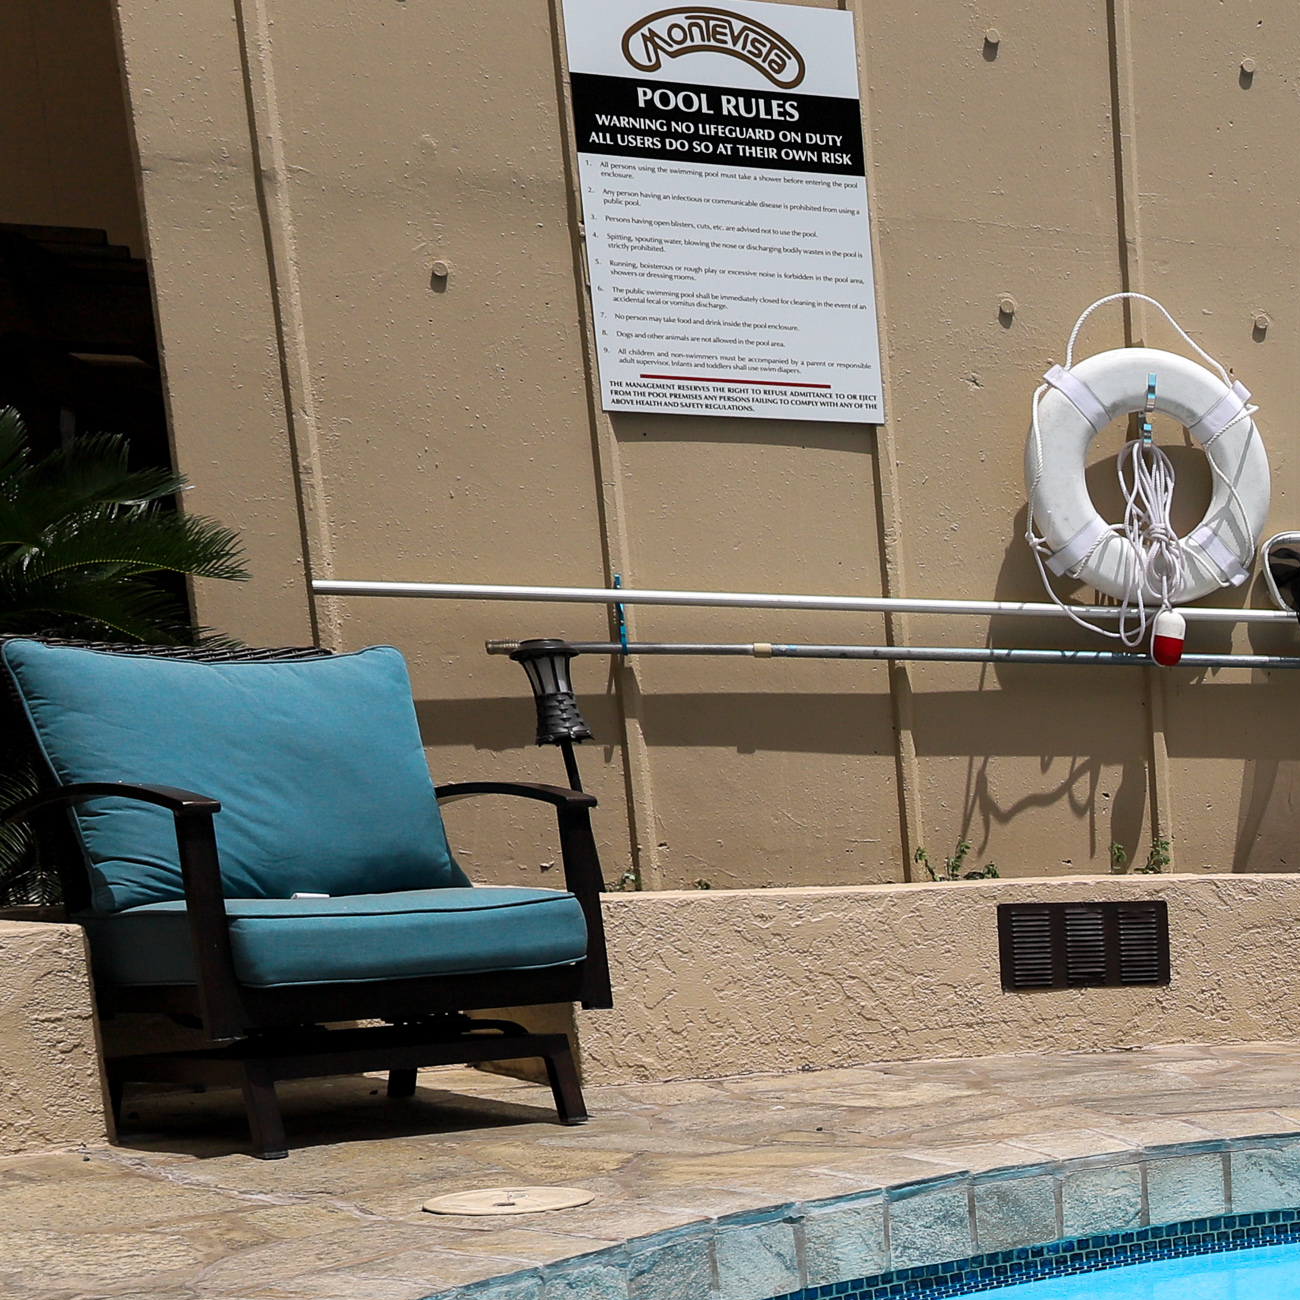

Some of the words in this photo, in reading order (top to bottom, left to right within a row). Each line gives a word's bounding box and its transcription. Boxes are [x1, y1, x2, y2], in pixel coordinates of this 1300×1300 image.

[636, 87, 714, 114] POOL
[720, 95, 799, 121] RULES
[595, 113, 667, 131] WARNING
[671, 121, 694, 134] NO
[698, 123, 775, 141] LIFEGUARD
[778, 130, 801, 143] ON
[805, 132, 842, 146] DUTY
[589, 131, 614, 145] ALL
[616, 133, 661, 149] USERS
[665, 138, 689, 151] DO
[692, 140, 713, 153] SO
[716, 143, 733, 155] AT
[736, 144, 778, 159] THEIR
[781, 148, 817, 162] OWN
[821, 151, 852, 165] RISK
[599, 160, 609, 168] All
[609, 162, 637, 171] persons
[637, 165, 656, 174] using
[656, 165, 668, 173] the
[668, 168, 704, 178] swimming
[703, 170, 719, 178] pool
[737, 172, 752, 181] take
[758, 174, 782, 183] shower
[782, 175, 804, 185] before
[804, 179, 832, 188] entering
[831, 180, 843, 188] the
[843, 181, 858, 189] pool
[602, 197, 623, 205] public
[602, 187, 616, 197] Any
[615, 190, 639, 198] person
[638, 190, 662, 201] having
[670, 193, 703, 203] infectious
[710, 198, 759, 207] communicable
[758, 200, 783, 209] disease
[788, 203, 822, 212] prohibited
[821, 205, 838, 213] from
[837, 207, 856, 216] using
[604, 214, 631, 224] Persons
[630, 216, 654, 227] having
[652, 219, 671, 227] open
[735, 225, 761, 233] advised
[607, 242, 630, 251] strictly
[634, 236, 663, 245] spouting
[683, 238, 710, 248] blowing
[745, 243, 783, 254] discharging
[781, 245, 802, 255] bodily
[842, 250, 857, 258] pool
[609, 268, 638, 277] showers
[645, 270, 674, 281] dressing
[638, 261, 674, 271] boisterous
[682, 265, 703, 274] rough
[703, 266, 718, 275] play
[726, 269, 758, 277] excessive
[782, 271, 814, 281] forbidden
[611, 285, 625, 294] The
[624, 287, 645, 296] public
[645, 289, 680, 299] swimming
[679, 291, 695, 299] pool
[695, 291, 711, 299] shall
[719, 293, 759, 304] immediately
[758, 296, 780, 304] closed
[779, 297, 789, 305] for
[789, 298, 817, 308] cleaning
[612, 295, 646, 304] accidental
[645, 296, 662, 305] fecal
[613, 312, 625, 320] No
[624, 314, 648, 322] person
[647, 316, 663, 324] may
[662, 315, 677, 323] take
[676, 316, 692, 325] food
[704, 318, 722, 326] drink
[752, 322, 767, 330] pool
[615, 330, 634, 339] Dogs
[646, 332, 664, 340] other
[712, 336, 738, 345] allowed
[754, 339, 770, 347] pool
[617, 347, 627, 355] All
[627, 348, 655, 357] children
[670, 352, 719, 360] non-swimmers
[747, 357, 790, 365] accompanied
[618, 356, 635, 364] adult
[670, 359, 693, 368] Infants
[705, 361, 732, 370] toddlers
[731, 363, 747, 371] shall
[608, 379, 624, 388] THE
[624, 380, 676, 391] MANAGEMENT
[676, 383, 711, 393] RESERVES
[711, 385, 726, 393] THE
[726, 386, 749, 395] RIGHT
[750, 387, 762, 395] TO
[762, 388, 788, 397] REFUSE
[788, 390, 833, 399] ADMITTANCE
[834, 392, 846, 400] TO
[858, 393, 877, 401] EJECT
[609, 388, 632, 397] FROM
[631, 389, 647, 398] THE
[646, 390, 669, 399] POOL
[668, 391, 703, 401] PREMISES
[702, 393, 718, 401] ANY
[717, 394, 751, 403] PERSONS
[750, 396, 779, 405] FAILING
[778, 397, 790, 405] TO
[789, 398, 819, 407] COMPLY
[818, 400, 839, 408] WITH
[852, 401, 864, 409] OF
[863, 402, 878, 410] THE
[610, 397, 635, 406] ABOVE
[634, 398, 663, 407] HEALTH
[662, 400, 680, 408] AND
[679, 401, 704, 409] SAFETY
[703, 402, 755, 412] REGULATIONS.
